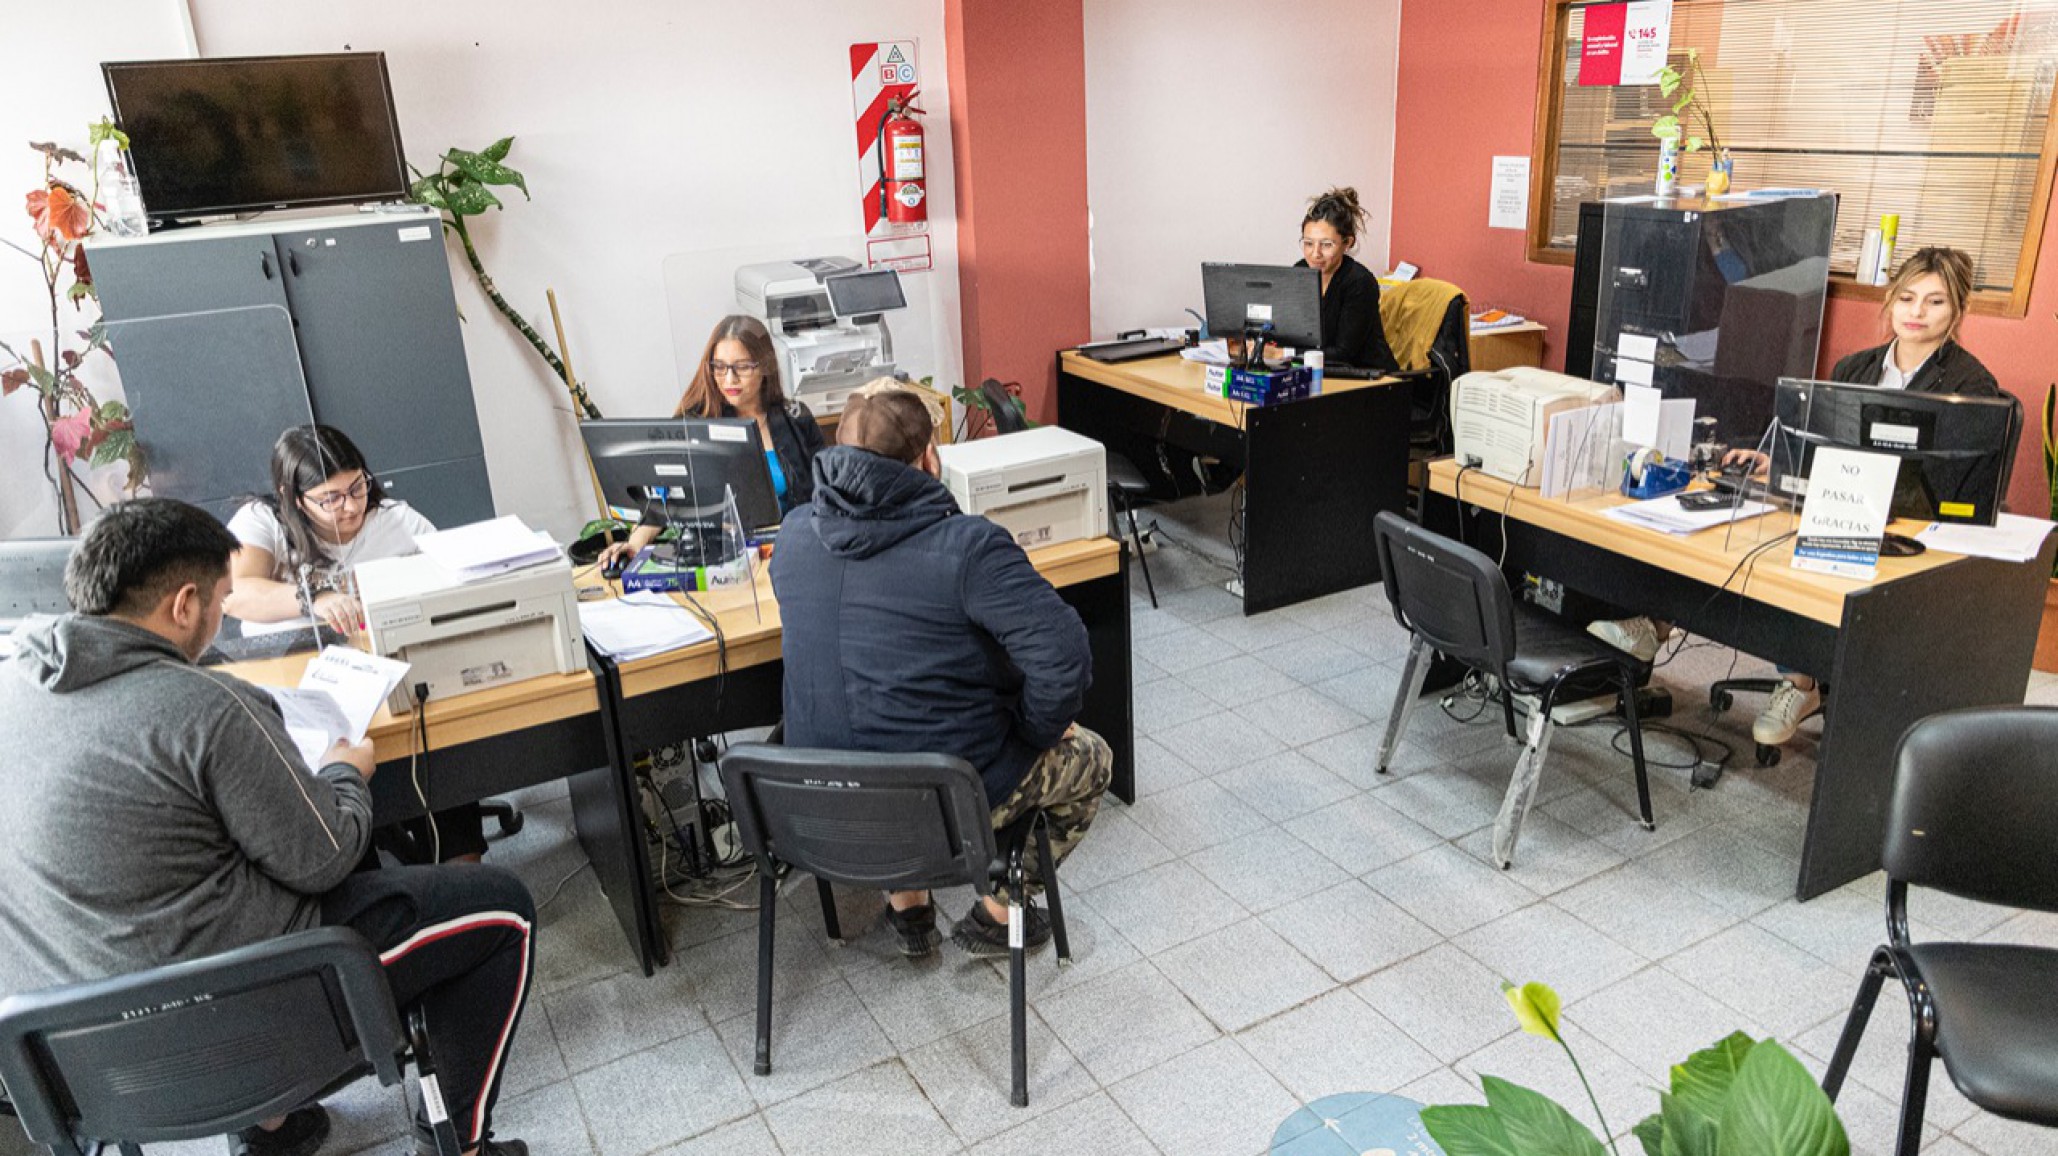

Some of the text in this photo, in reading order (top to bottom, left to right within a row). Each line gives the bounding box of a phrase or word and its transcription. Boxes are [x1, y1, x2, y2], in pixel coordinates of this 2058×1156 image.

[1639, 27, 1657, 39] 145
[884, 69, 910, 79] B C
[1841, 464, 1860, 476] NO
[1822, 488, 1864, 505] PASAR
[1812, 515, 1871, 533] GRACIAS
